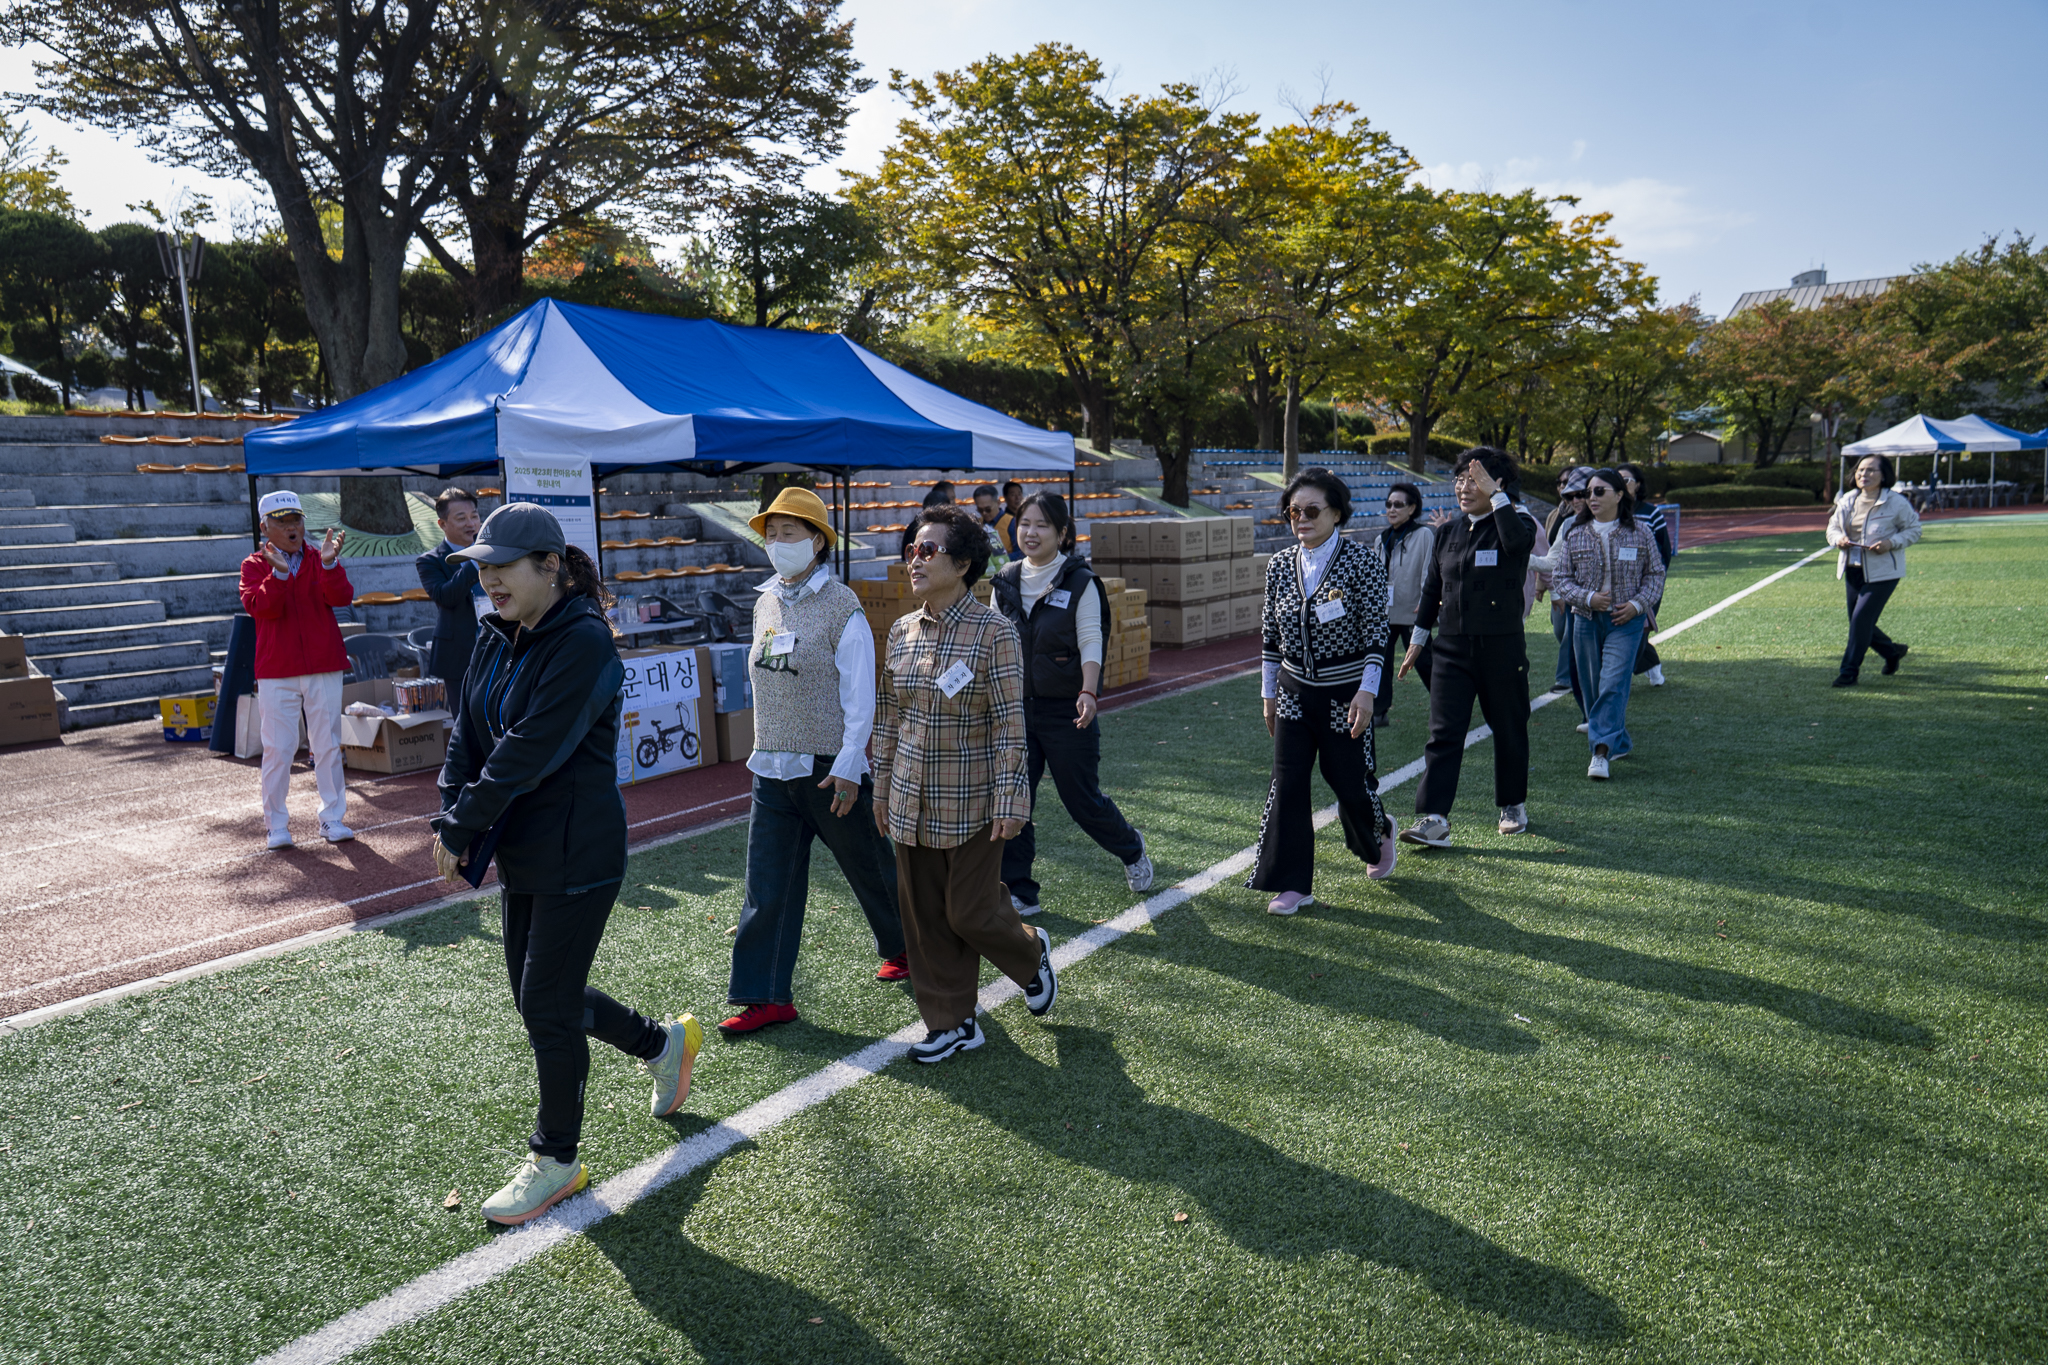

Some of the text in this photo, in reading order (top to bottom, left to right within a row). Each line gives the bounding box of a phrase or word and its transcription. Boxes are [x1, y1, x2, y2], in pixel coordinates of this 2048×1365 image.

[514, 467, 582, 478] 2025 제23회 한마음축제
[536, 479, 561, 488] 후원내역
[622, 657, 695, 699] 운대상
[398, 733, 435, 746] coupang
